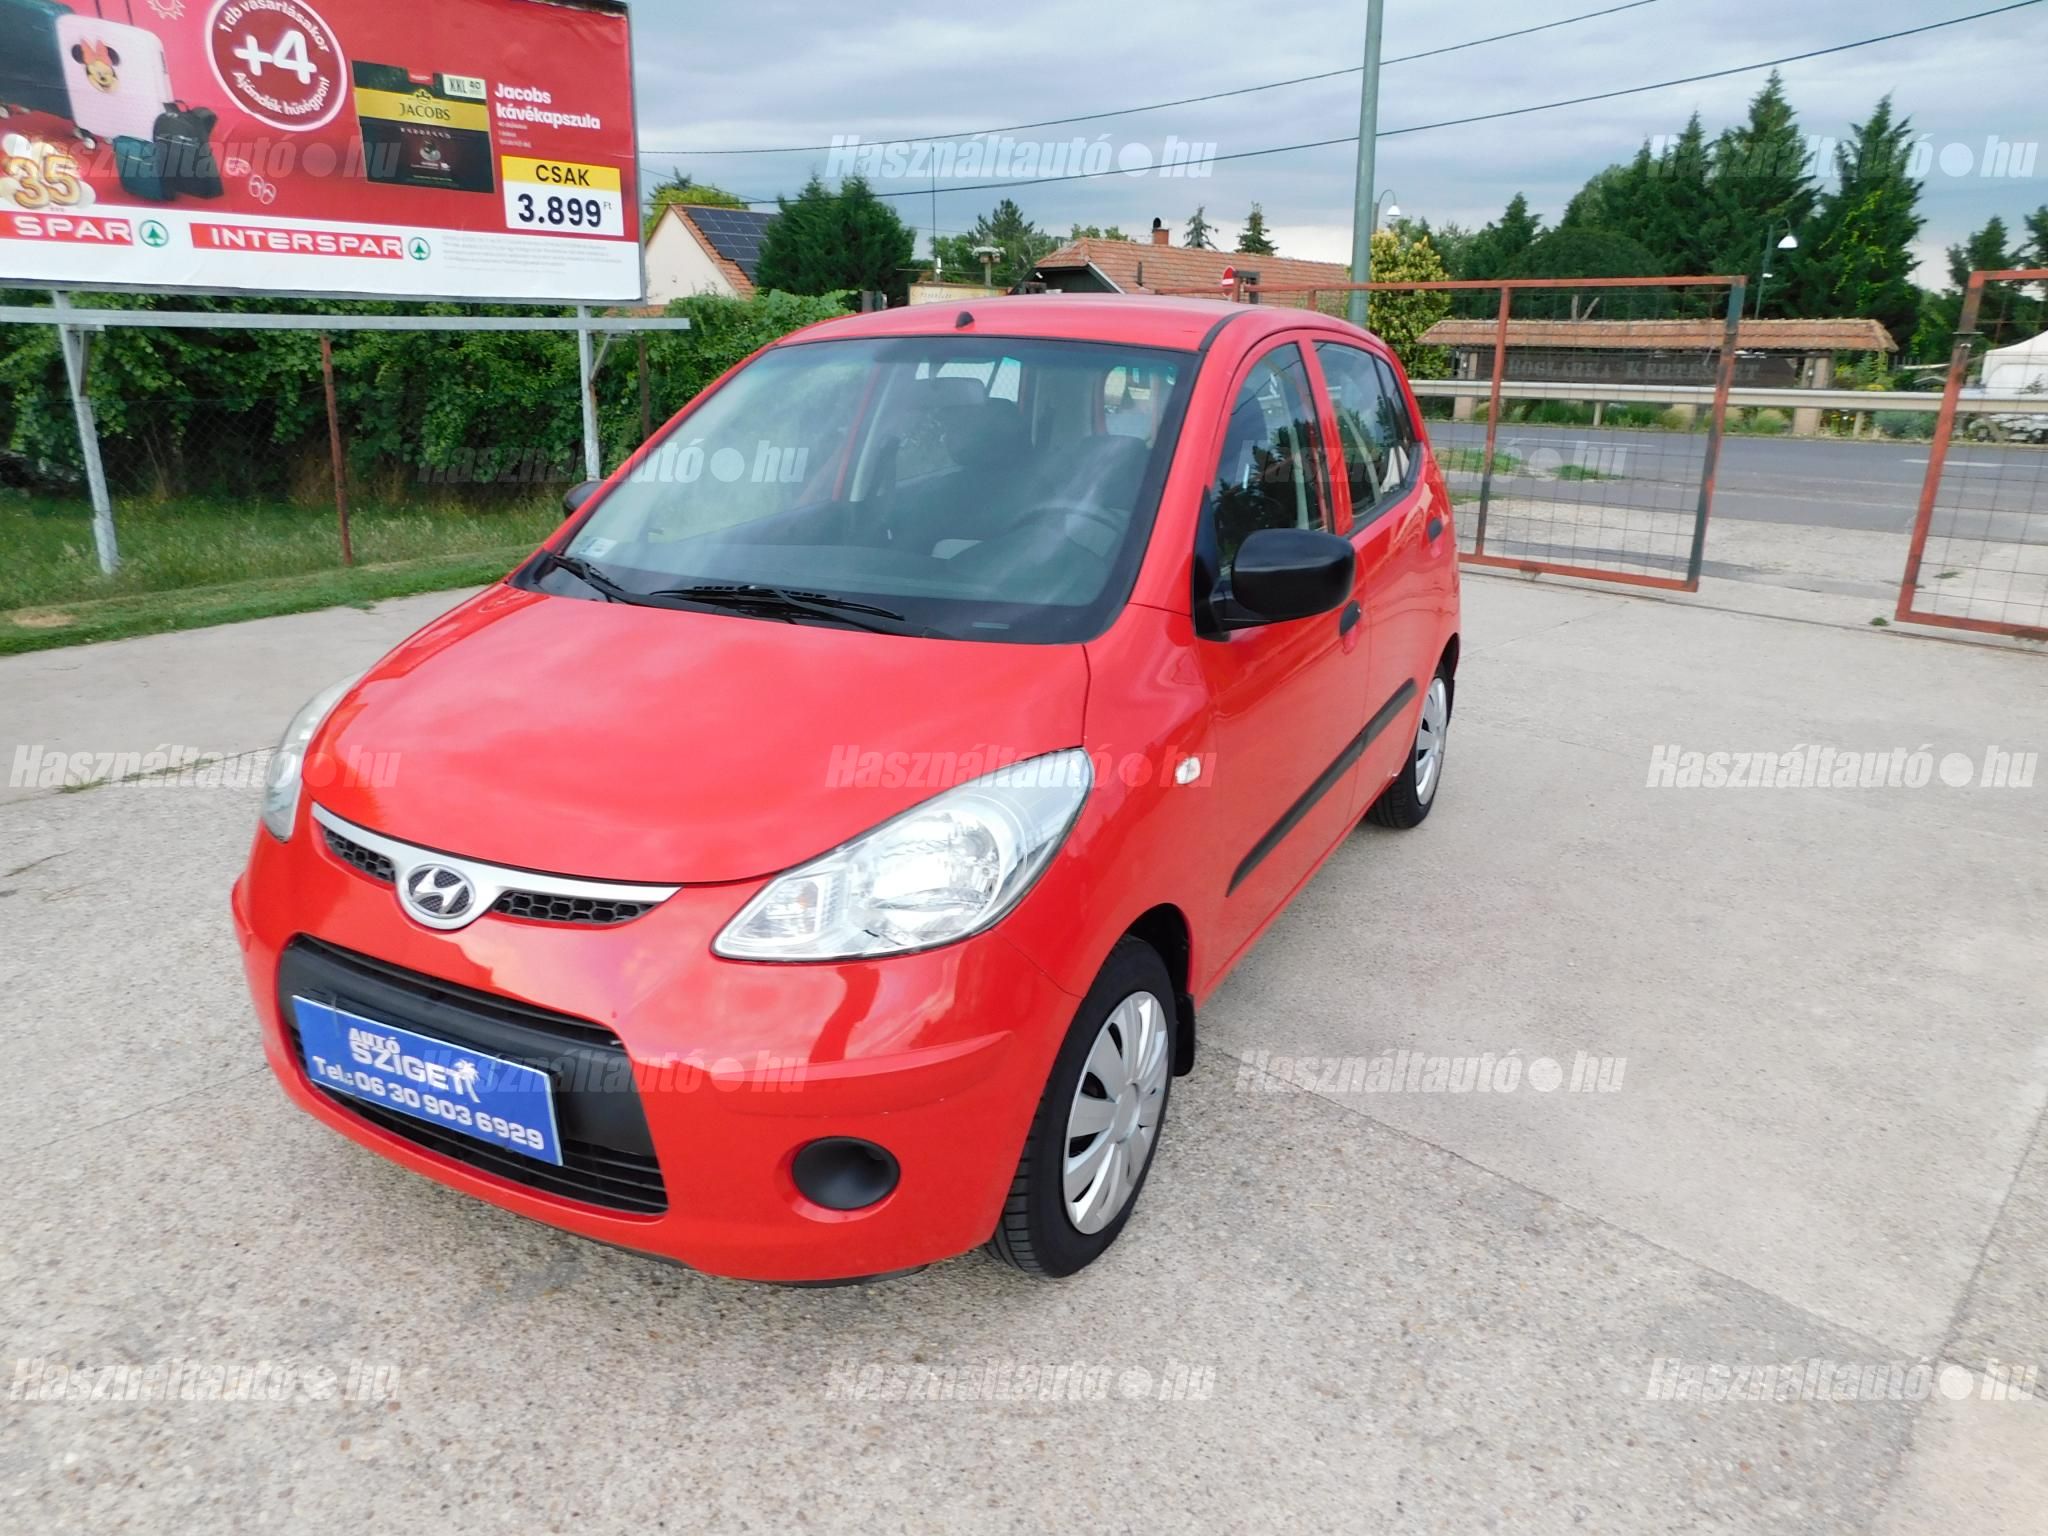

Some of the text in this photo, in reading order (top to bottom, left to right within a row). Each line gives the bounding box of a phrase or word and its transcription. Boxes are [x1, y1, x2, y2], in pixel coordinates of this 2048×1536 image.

[233, 30, 317, 84] +4
[495, 82, 552, 104] Jacobs
[400, 102, 452, 121] JACOBS
[495, 102, 601, 129] kávékapszula
[4, 155, 82, 209] 35
[535, 164, 591, 186] CSAK
[517, 193, 612, 228] 3.899 Ft
[13, 216, 132, 241] SPAR
[210, 227, 403, 256] INTERSPAR
[349, 1027, 401, 1055] AUTÓ
[354, 1070, 386, 1097] 06
[387, 1082, 421, 1109] 30
[422, 1093, 473, 1126] 903
[475, 1110, 545, 1151] 6929
